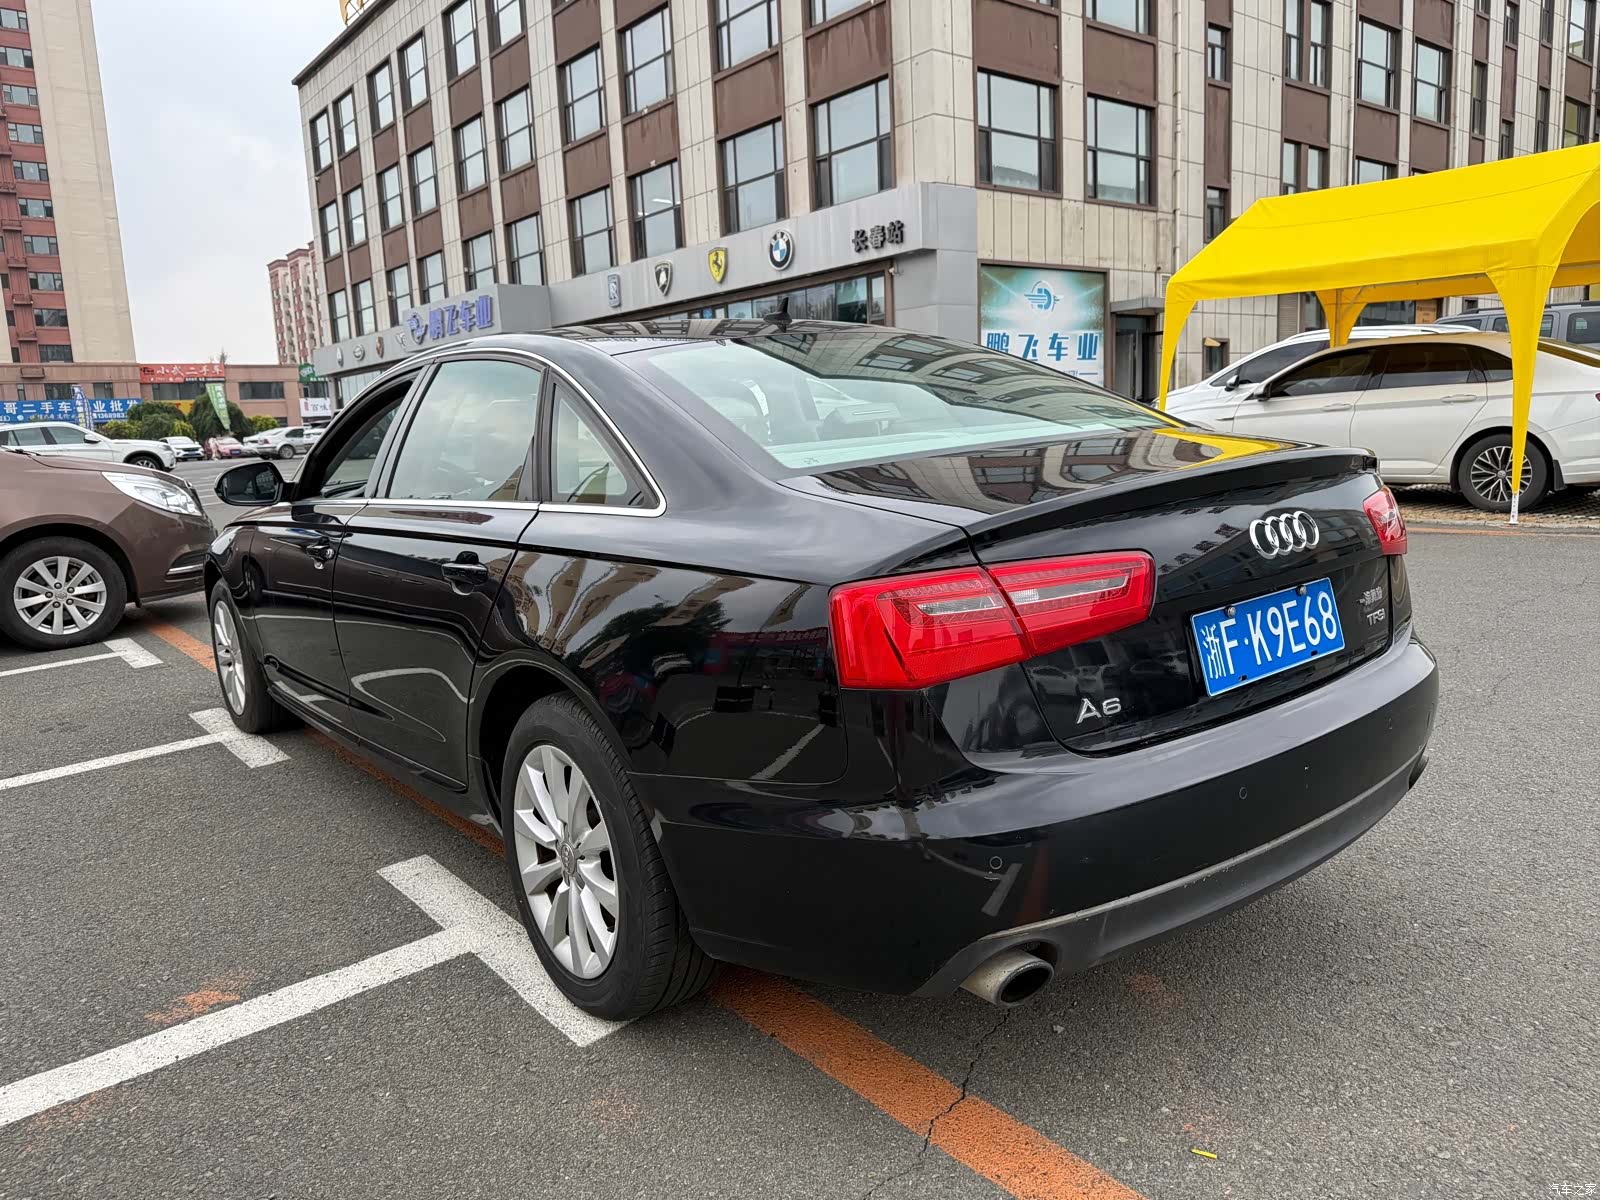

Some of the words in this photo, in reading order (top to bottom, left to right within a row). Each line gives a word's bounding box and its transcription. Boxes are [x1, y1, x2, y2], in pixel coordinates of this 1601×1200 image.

[852, 219, 905, 254] 长春站
[429, 295, 493, 340] 鹏飞车业
[987, 333, 1098, 361] 鹏飞车业
[1367, 608, 1385, 626] TFSI
[1077, 697, 1122, 725] A6
